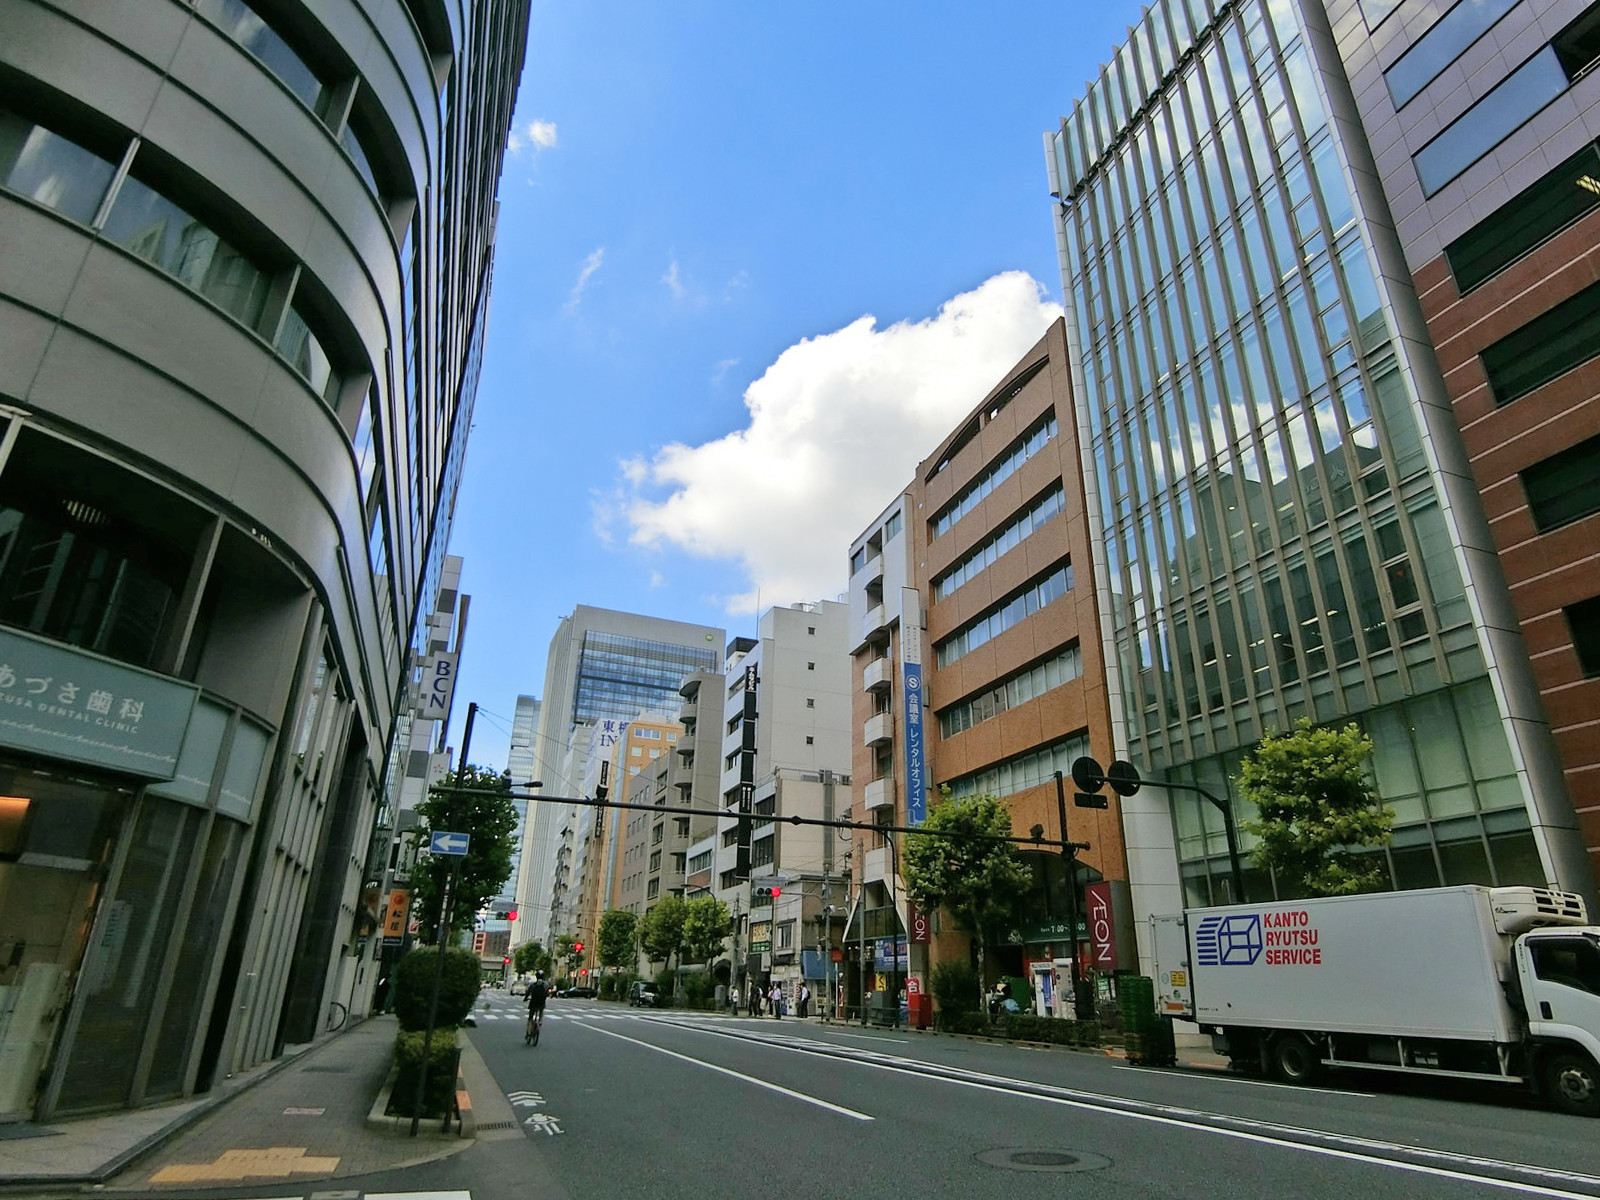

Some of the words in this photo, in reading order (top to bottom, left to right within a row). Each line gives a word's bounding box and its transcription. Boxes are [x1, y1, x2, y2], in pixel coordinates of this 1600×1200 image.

[0, 663, 145, 723] あづさ歯科
[430, 660, 451, 710] BCN
[38, 702, 91, 723] DENTAL
[95, 716, 140, 734] CLINIC
[1263, 911, 1309, 929] KANTO
[1265, 930, 1319, 947] RYUTSU
[1265, 948, 1322, 965] SERVICE
